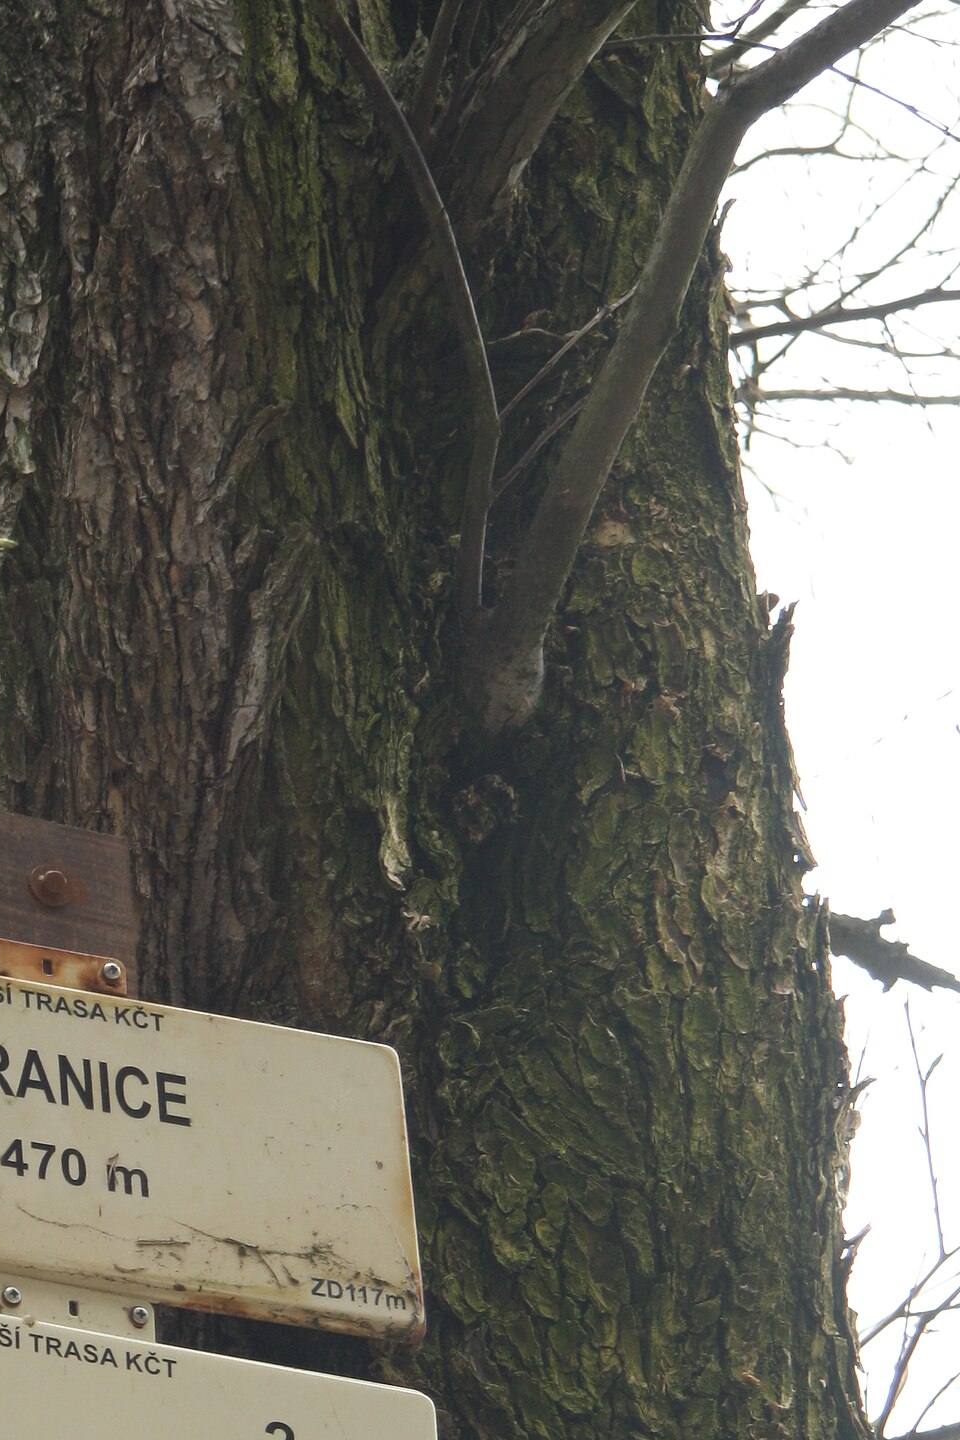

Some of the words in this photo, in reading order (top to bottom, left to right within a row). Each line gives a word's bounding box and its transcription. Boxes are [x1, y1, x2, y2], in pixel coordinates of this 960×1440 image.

[19, 991, 108, 1023] TRASA
[113, 1005, 164, 1032] KČT
[0, 1138, 87, 1187] 470
[107, 1161, 149, 1198] m
[310, 1277, 407, 1311] ZD117m
[28, 1333, 117, 1367] TRASA
[126, 1350, 177, 1378] KČT
